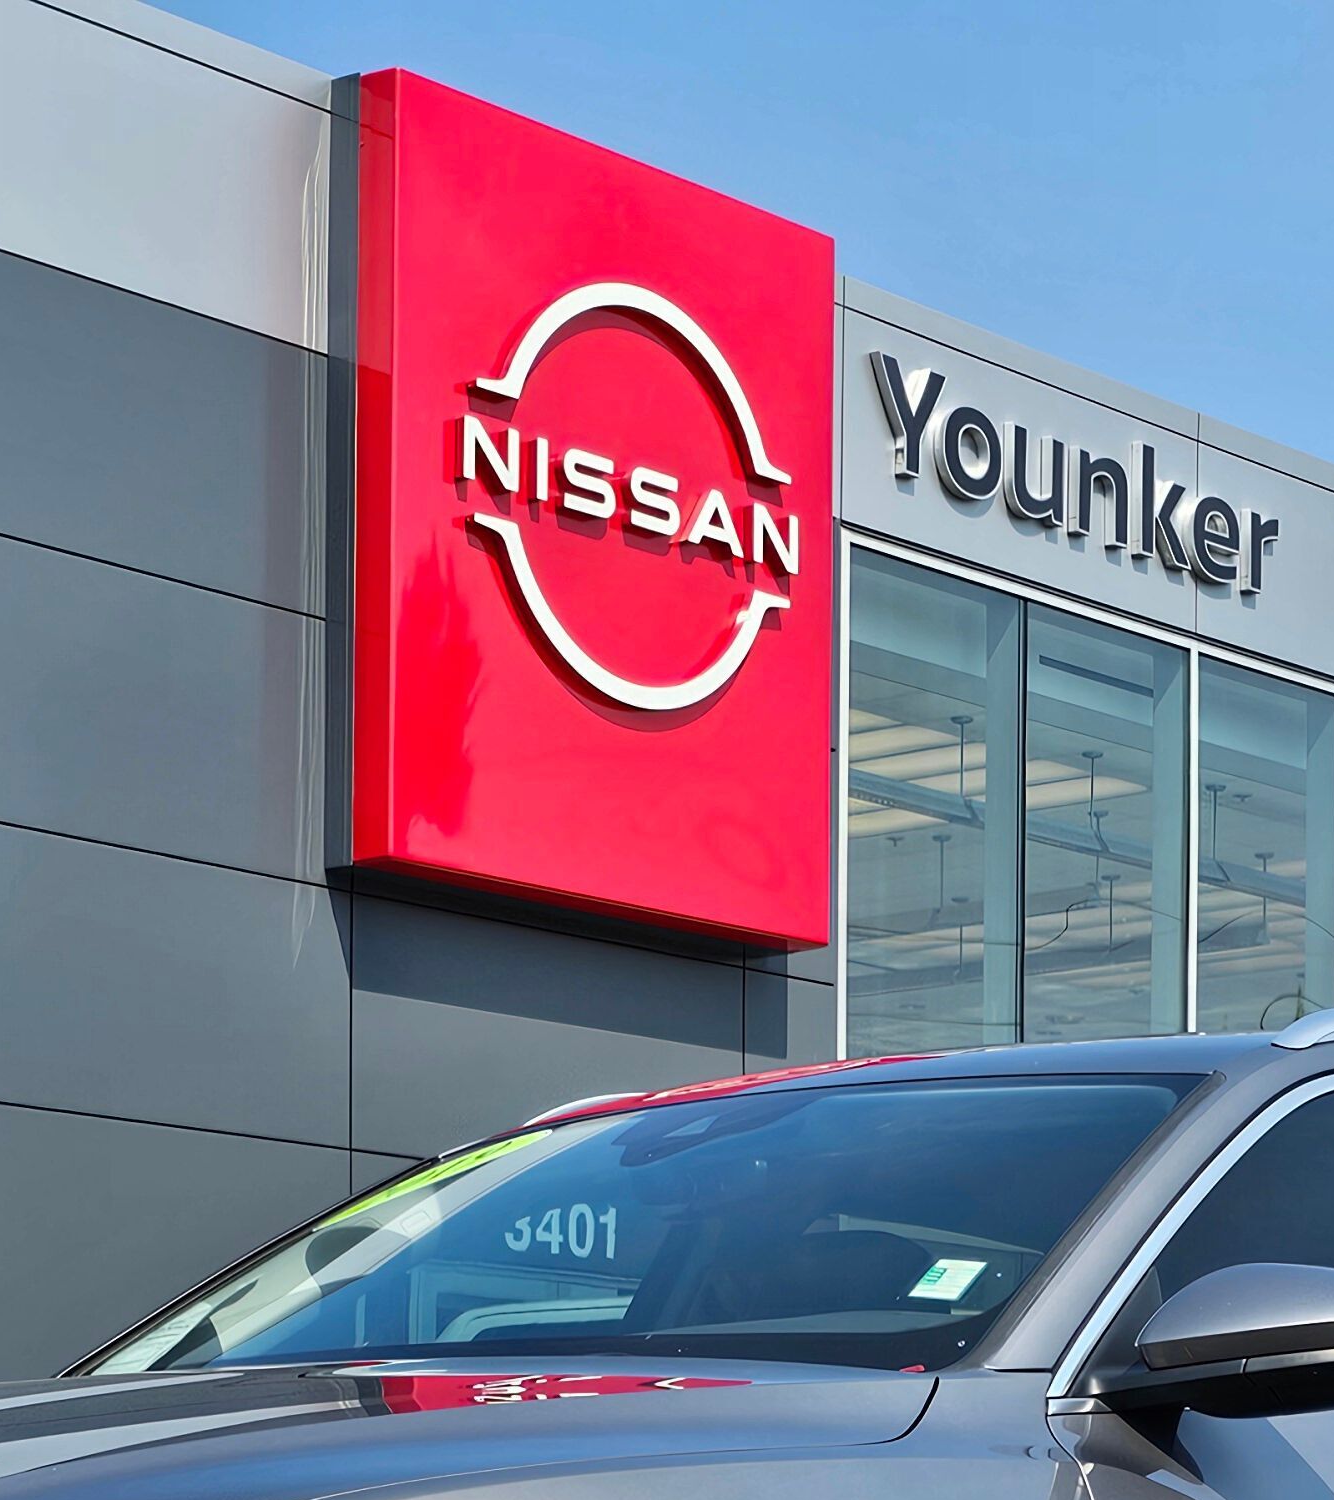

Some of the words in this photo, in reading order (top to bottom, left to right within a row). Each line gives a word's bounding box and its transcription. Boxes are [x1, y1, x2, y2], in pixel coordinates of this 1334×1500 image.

[462, 415, 799, 575] NISSAN
[869, 350, 1279, 595] Younker
[504, 1203, 617, 1260] 3401
